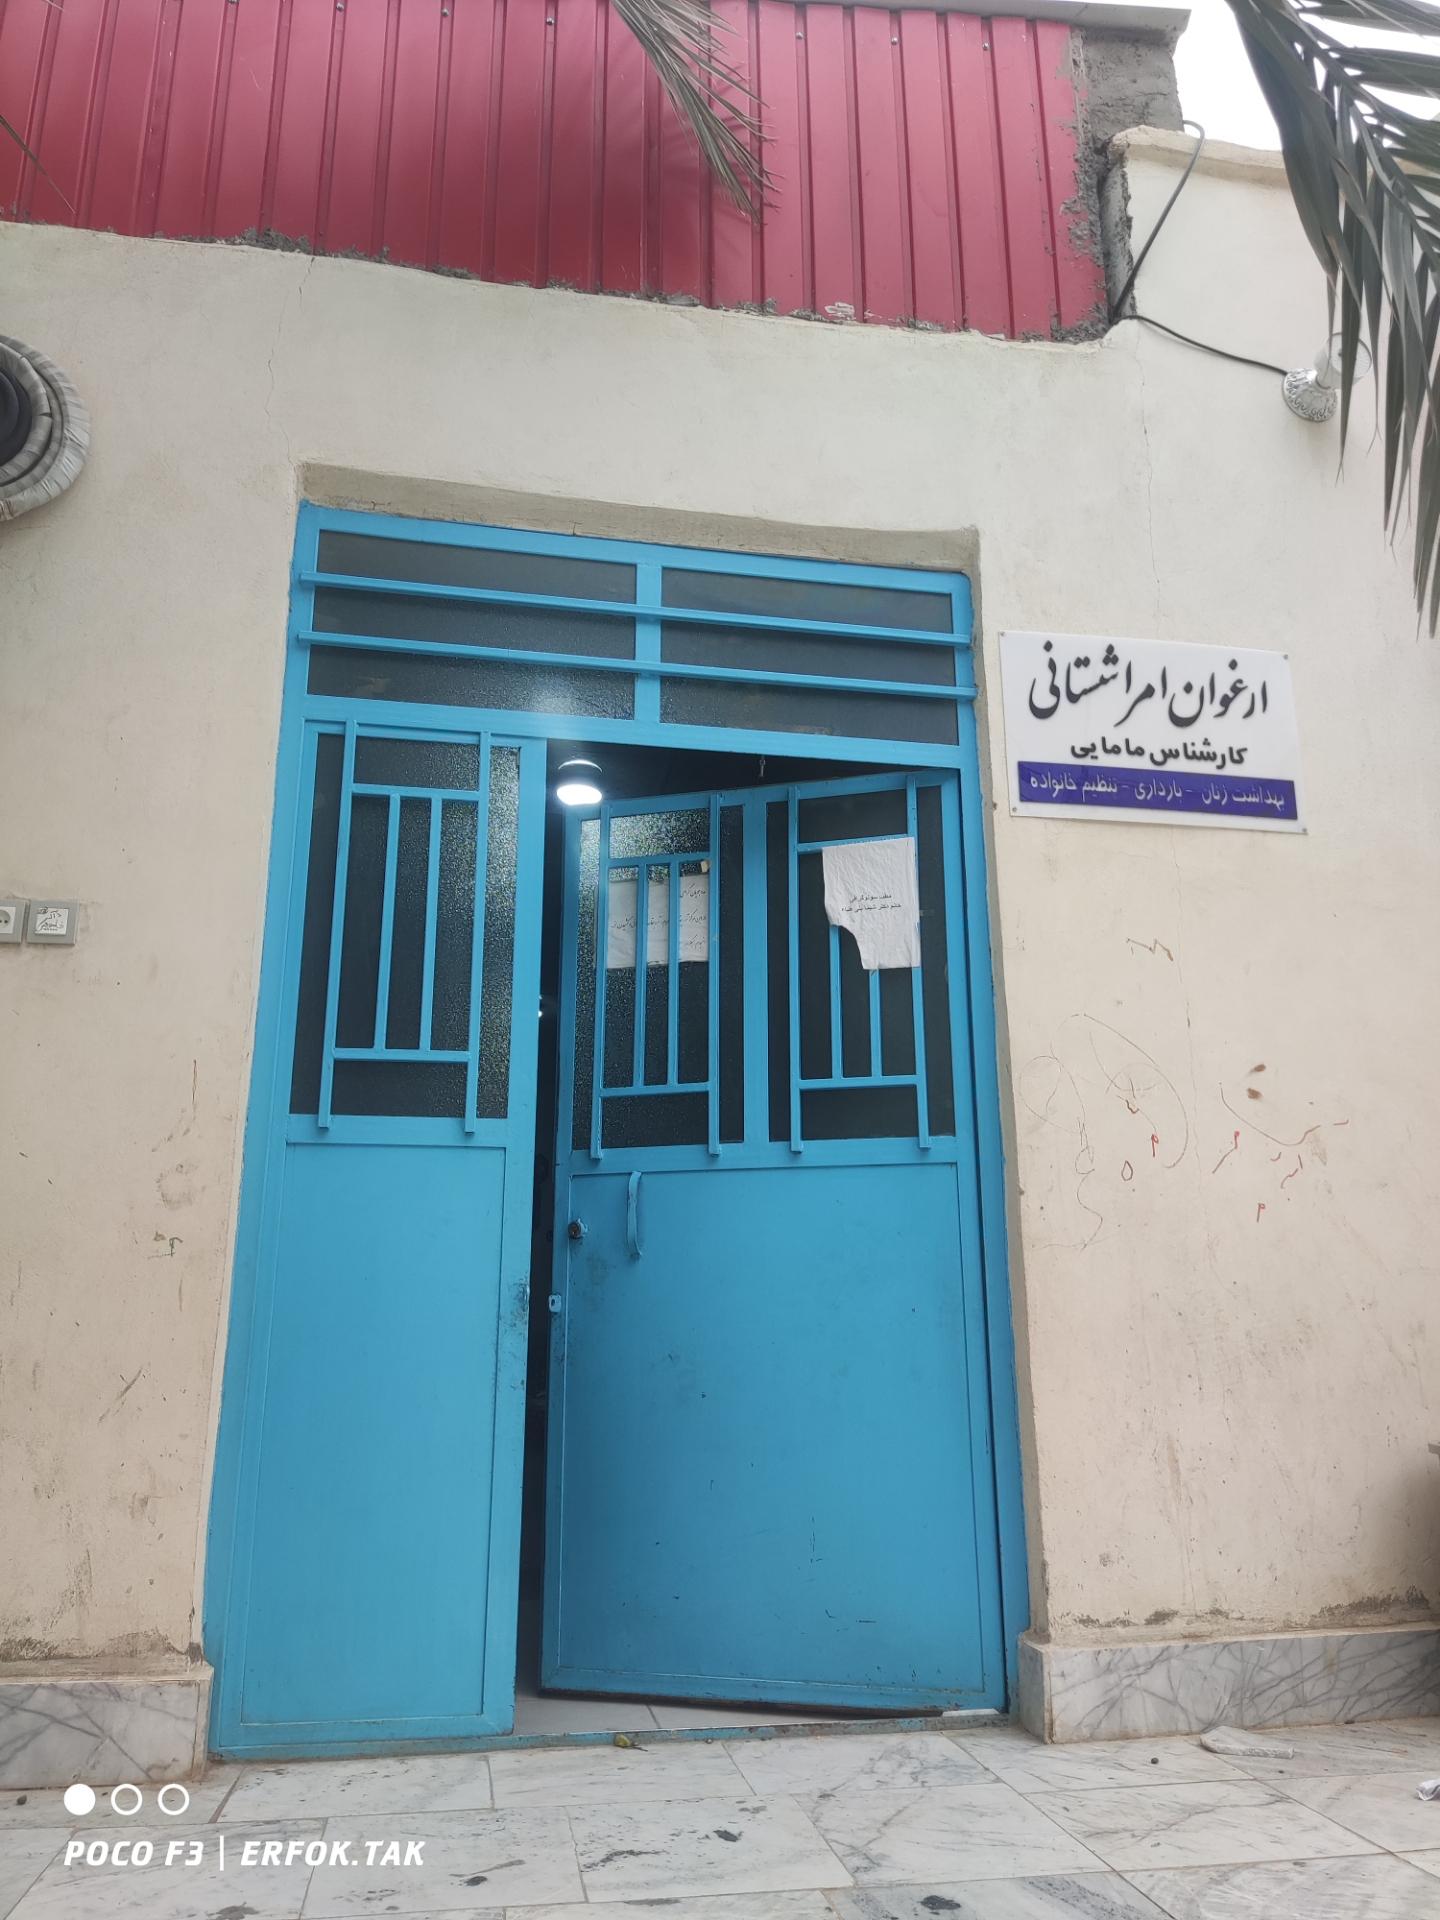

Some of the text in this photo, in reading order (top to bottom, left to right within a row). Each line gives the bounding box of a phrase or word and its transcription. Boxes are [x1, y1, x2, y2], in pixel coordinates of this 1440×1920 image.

[1168, 659, 1268, 728] ارغوان
[1071, 736, 1248, 770] کارشناس مامایی
[1030, 771, 1285, 812] بهداشت زنان بارداری تنظیم خانواده
